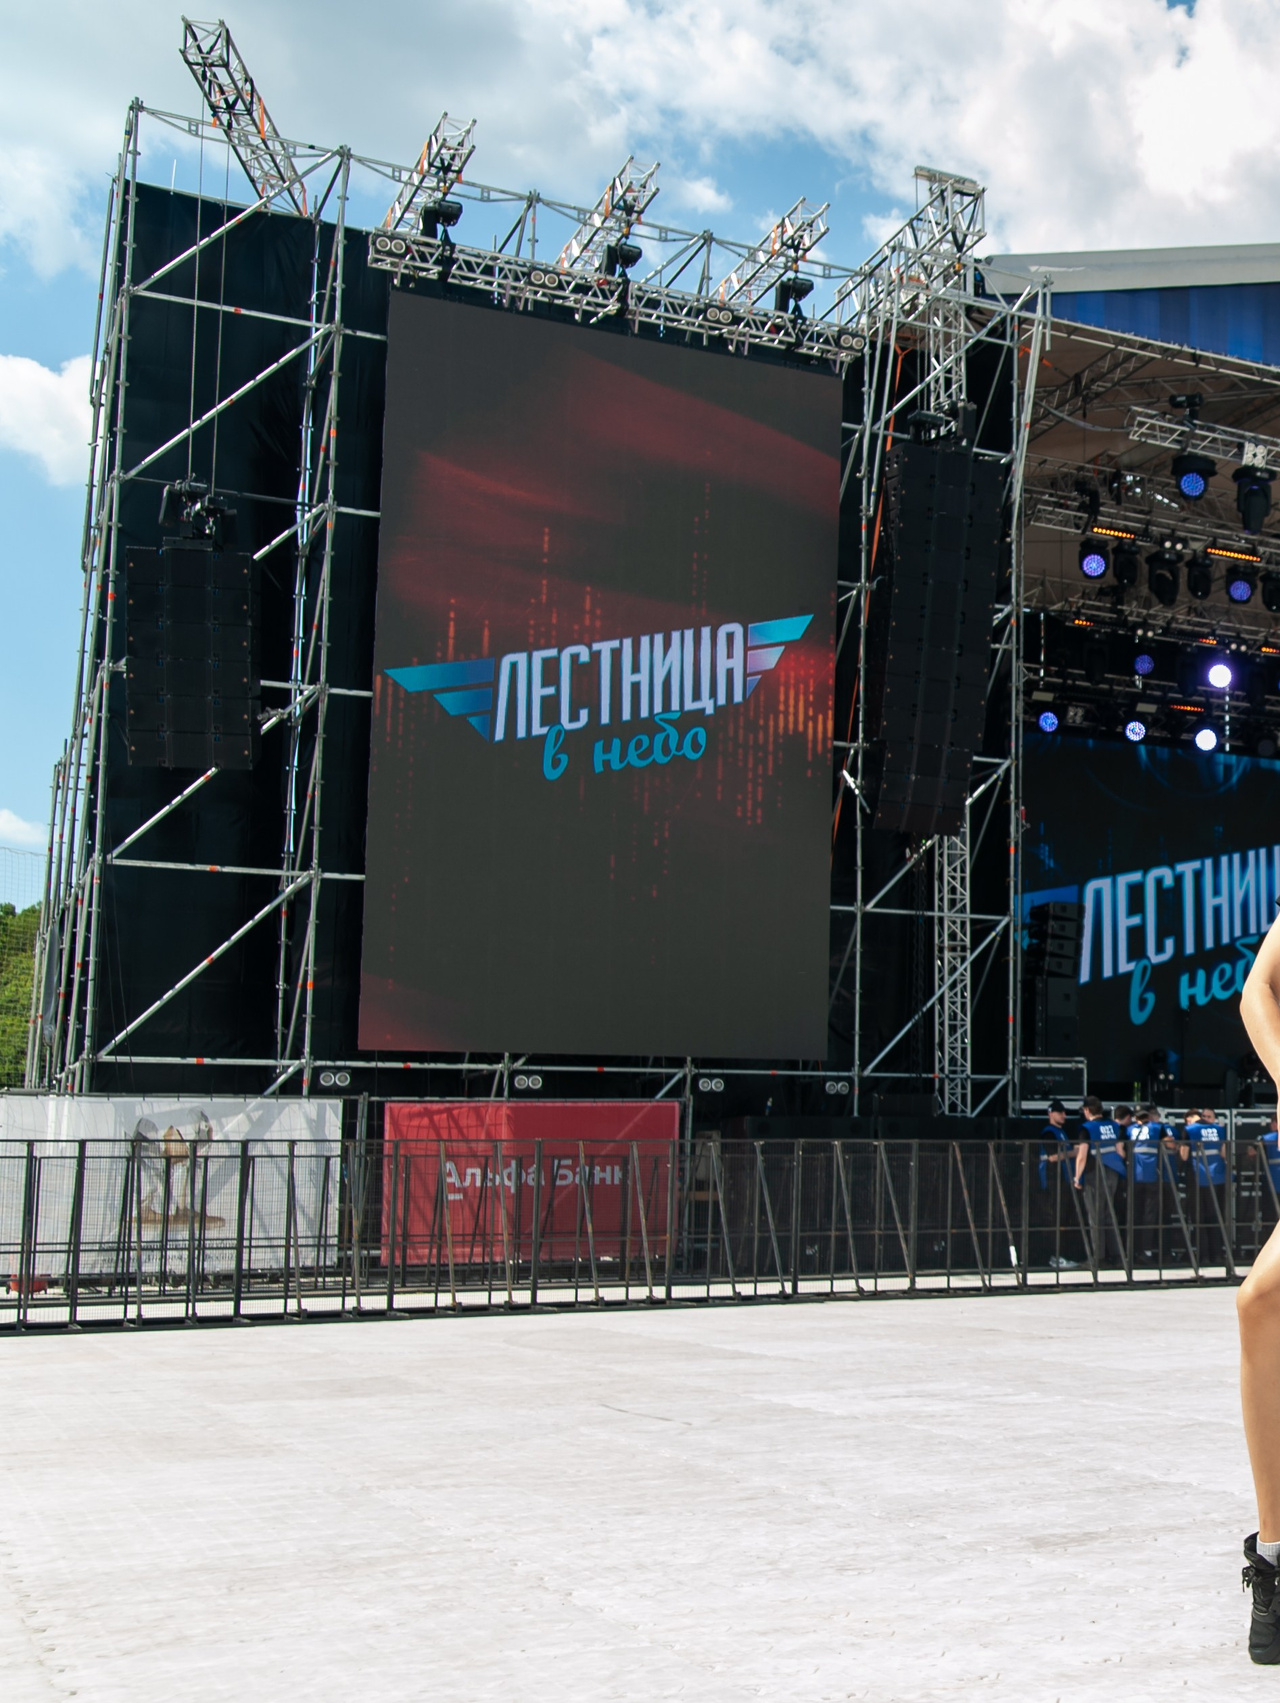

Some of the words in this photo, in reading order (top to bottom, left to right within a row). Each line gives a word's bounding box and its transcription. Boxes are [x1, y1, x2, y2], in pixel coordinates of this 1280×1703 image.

[494, 622, 745, 743] ЛЕСТНИЦА
[542, 723, 569, 782] в
[592, 711, 708, 775] небо
[1130, 960, 1156, 1025] в
[1179, 937, 1259, 1010] неб
